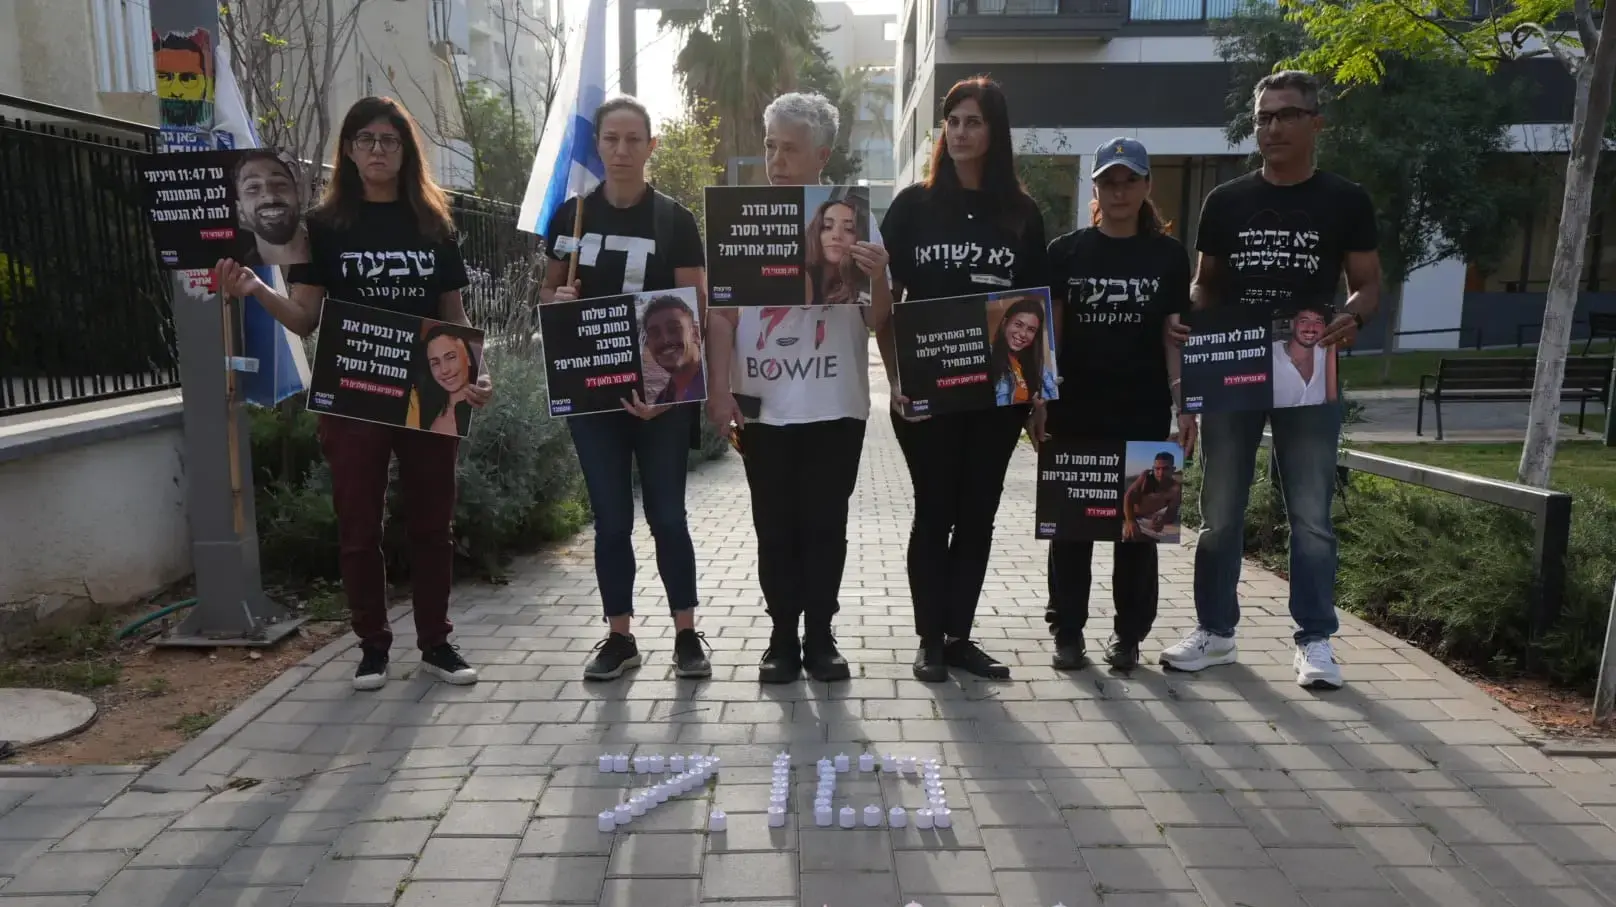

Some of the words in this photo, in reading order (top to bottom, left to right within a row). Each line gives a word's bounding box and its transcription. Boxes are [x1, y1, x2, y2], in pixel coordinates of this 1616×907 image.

[144, 170, 176, 182] חיכיתי
[178, 168, 206, 180] 11:47
[208, 167, 224, 179] עד
[156, 189, 200, 203] התחננתי,
[204, 185, 226, 202] לכם,
[151, 209, 190, 222] הגעתם?
[192, 207, 205, 220] לא
[208, 205, 229, 219] למה
[741, 204, 768, 216] הדרג
[770, 204, 798, 216] מדוע
[730, 224, 759, 236] מסרב
[762, 224, 798, 236] המדיני
[718, 244, 764, 257] אחריות?
[767, 241, 798, 258] לקחת
[358, 286, 426, 300] באוקטובר
[581, 307, 606, 321] שלחו
[608, 304, 628, 318] למה
[1076, 312, 1142, 324] באוקטובר
[342, 318, 360, 332] את
[578, 324, 601, 337] שהיו
[603, 320, 630, 334] כוחות
[362, 324, 393, 340] נבטיח
[395, 328, 414, 344] איך
[916, 333, 927, 344] על
[928, 329, 965, 343] האחראים
[966, 327, 982, 339] מתי
[1228, 328, 1242, 342] לא
[1243, 326, 1266, 340] למה
[346, 337, 374, 353] ילדיי
[596, 336, 632, 350] במסיבה
[942, 343, 957, 355] שלי
[958, 341, 984, 353] המוות
[375, 343, 411, 362] ביטחון
[593, 350, 633, 368] למקומות
[973, 354, 986, 364] את
[1183, 352, 1209, 364] יריחו?
[1211, 350, 1234, 362] חומת
[1236, 345, 1266, 361] למסמך
[336, 354, 368, 372] נוסף?
[554, 357, 591, 371] אחרים?
[746, 355, 838, 381] BOWIE
[942, 355, 972, 369] המחיר?
[369, 359, 408, 380] ממחדל
[1055, 452, 1069, 465] לנו
[1071, 454, 1097, 466] חסמו
[1099, 453, 1120, 467] למה
[1042, 470, 1078, 482] הבריחה
[1080, 471, 1102, 483] נתיב
[1104, 472, 1119, 483] את
[1067, 487, 1118, 500] מהמסיבה?
